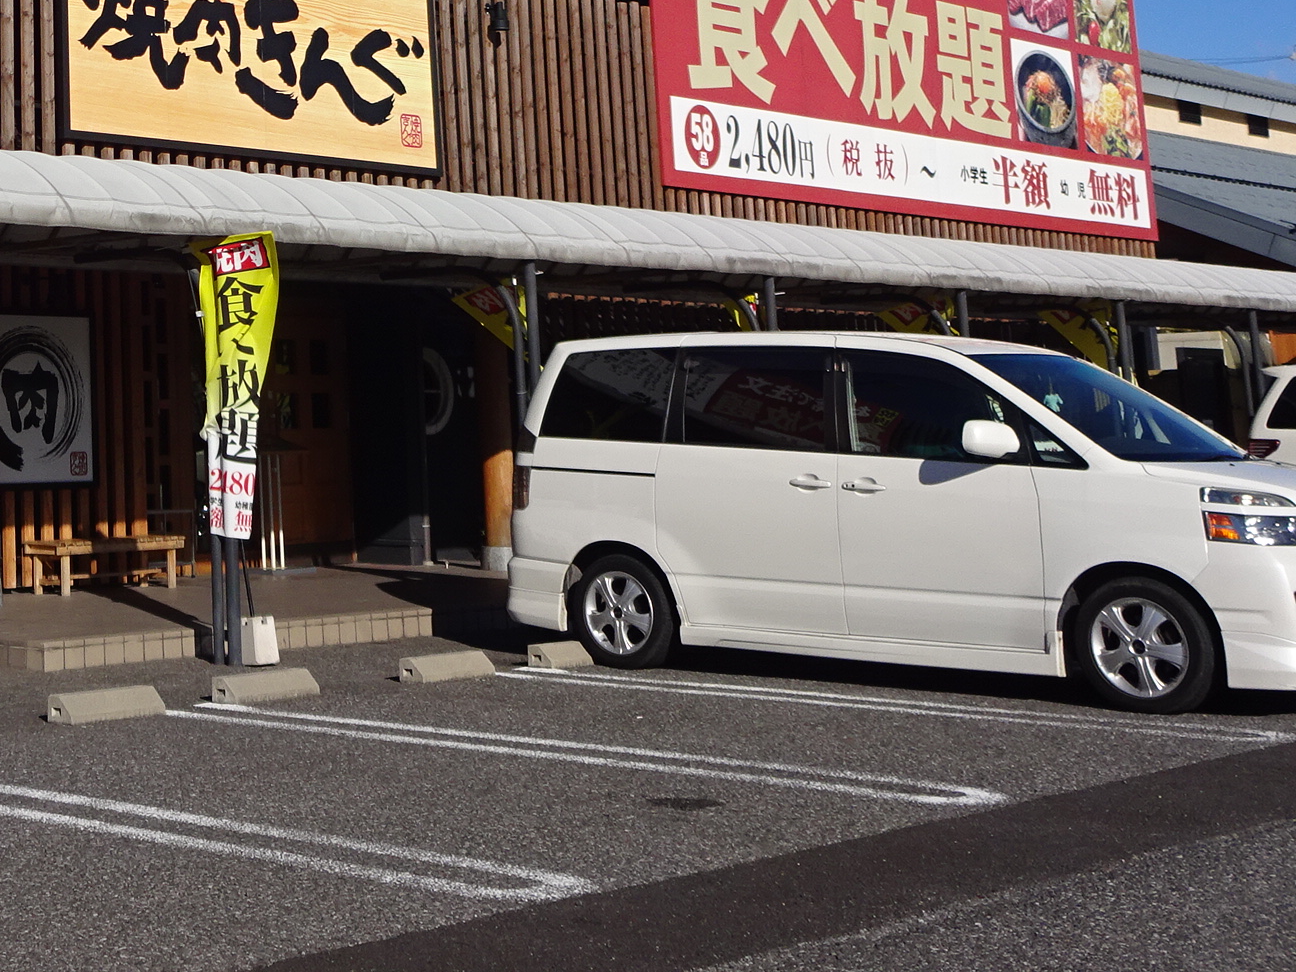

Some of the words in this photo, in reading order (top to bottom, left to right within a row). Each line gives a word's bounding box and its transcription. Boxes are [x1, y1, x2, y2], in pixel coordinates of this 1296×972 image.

[690, 112, 715, 152] 58
[699, 151, 709, 167] 品
[960, 165, 989, 185] 小学生
[992, 155, 1051, 210] 半額
[1060, 179, 1087, 199] 幼児
[1087, 168, 1140, 220] 無料
[1, 360, 58, 444] 肉
